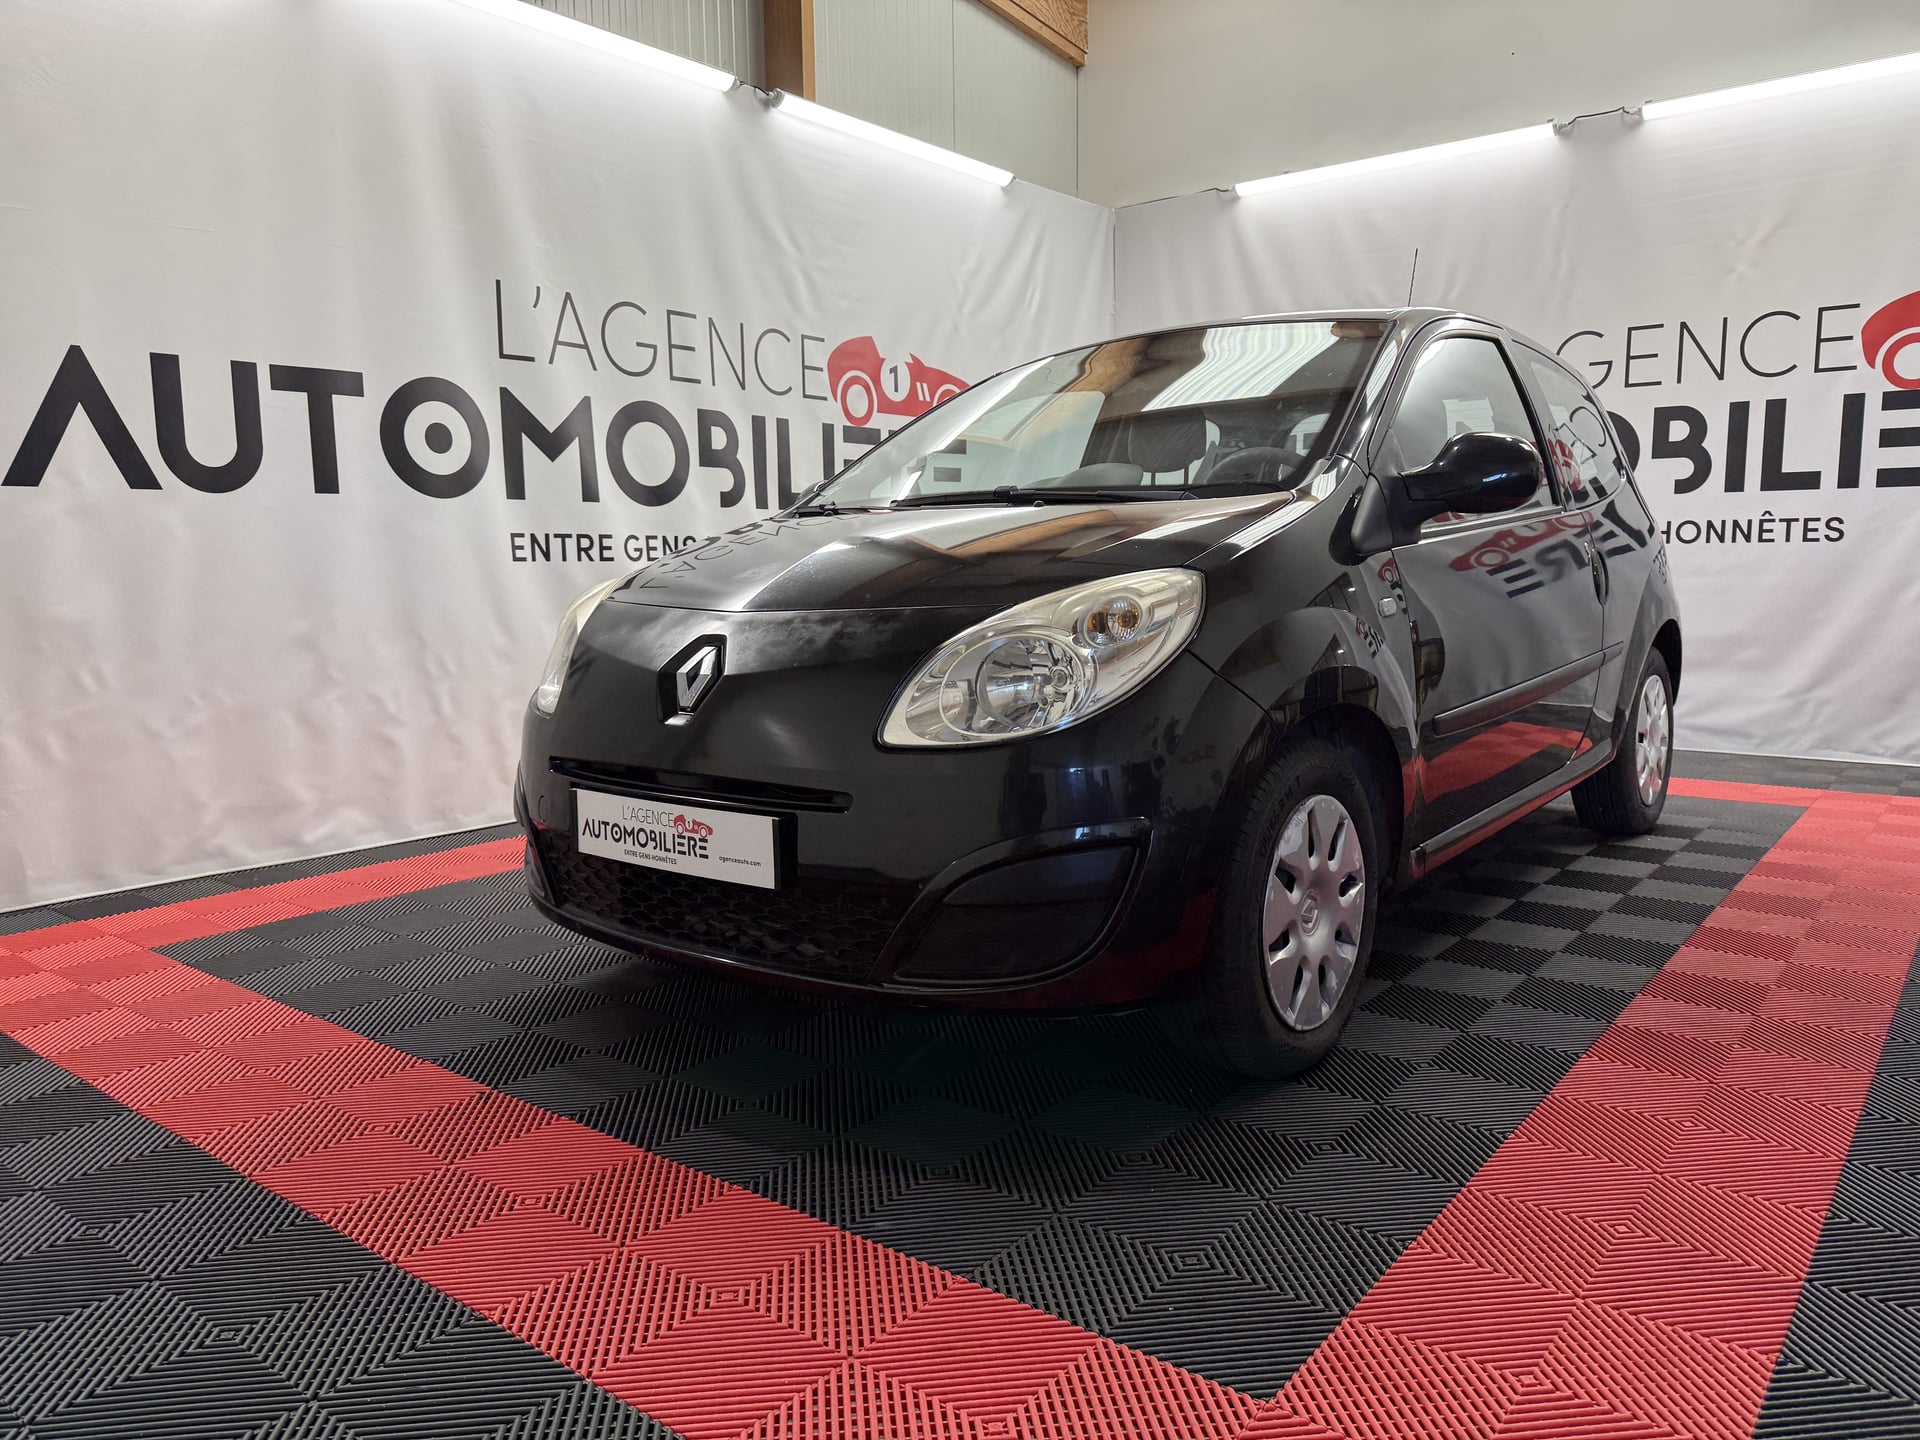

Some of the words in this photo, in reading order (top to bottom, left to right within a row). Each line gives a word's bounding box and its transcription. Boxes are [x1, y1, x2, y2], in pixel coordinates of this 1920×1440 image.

[495, 279, 828, 401] L'AGENCE
[1, 344, 967, 509] AUTOMOBILI
[510, 533, 615, 562] ENTRE
[622, 805, 675, 828] L'AGENCE
[582, 817, 709, 860] AUTOMOBILIERE
[624, 849, 638, 858] ENTRE
[638, 851, 651, 860] GENS
[718, 855, 762, 867] agenceauto.com
